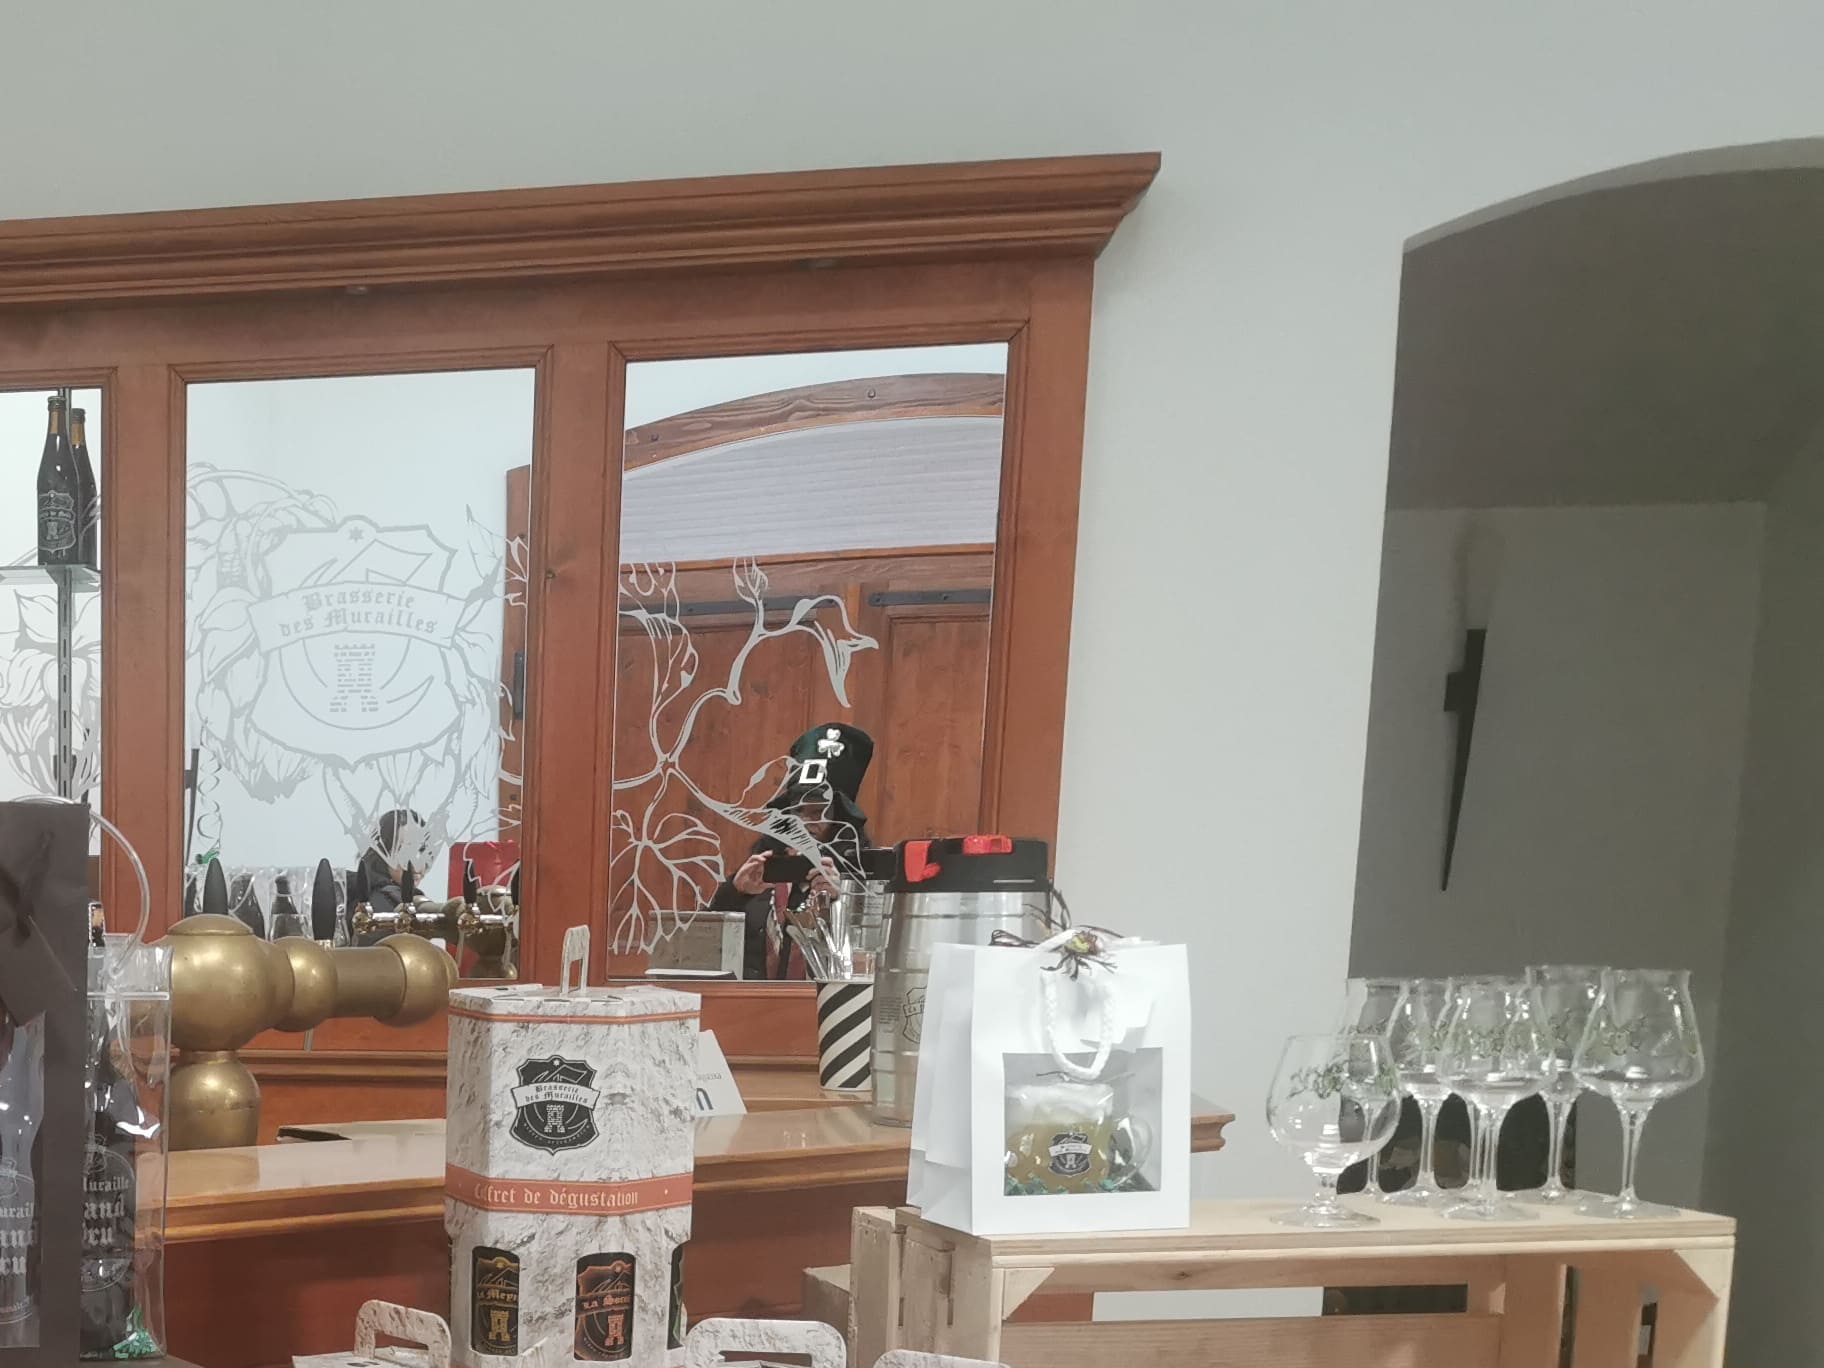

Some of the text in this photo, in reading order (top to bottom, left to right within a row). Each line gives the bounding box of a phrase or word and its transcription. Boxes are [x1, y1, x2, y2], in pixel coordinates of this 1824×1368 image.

[303, 589, 415, 611] Brasserie
[279, 608, 438, 637] des Murailles
[544, 1092, 588, 1104] Murailles
[524, 1188, 541, 1204] de
[549, 1187, 638, 1209] dégustation
